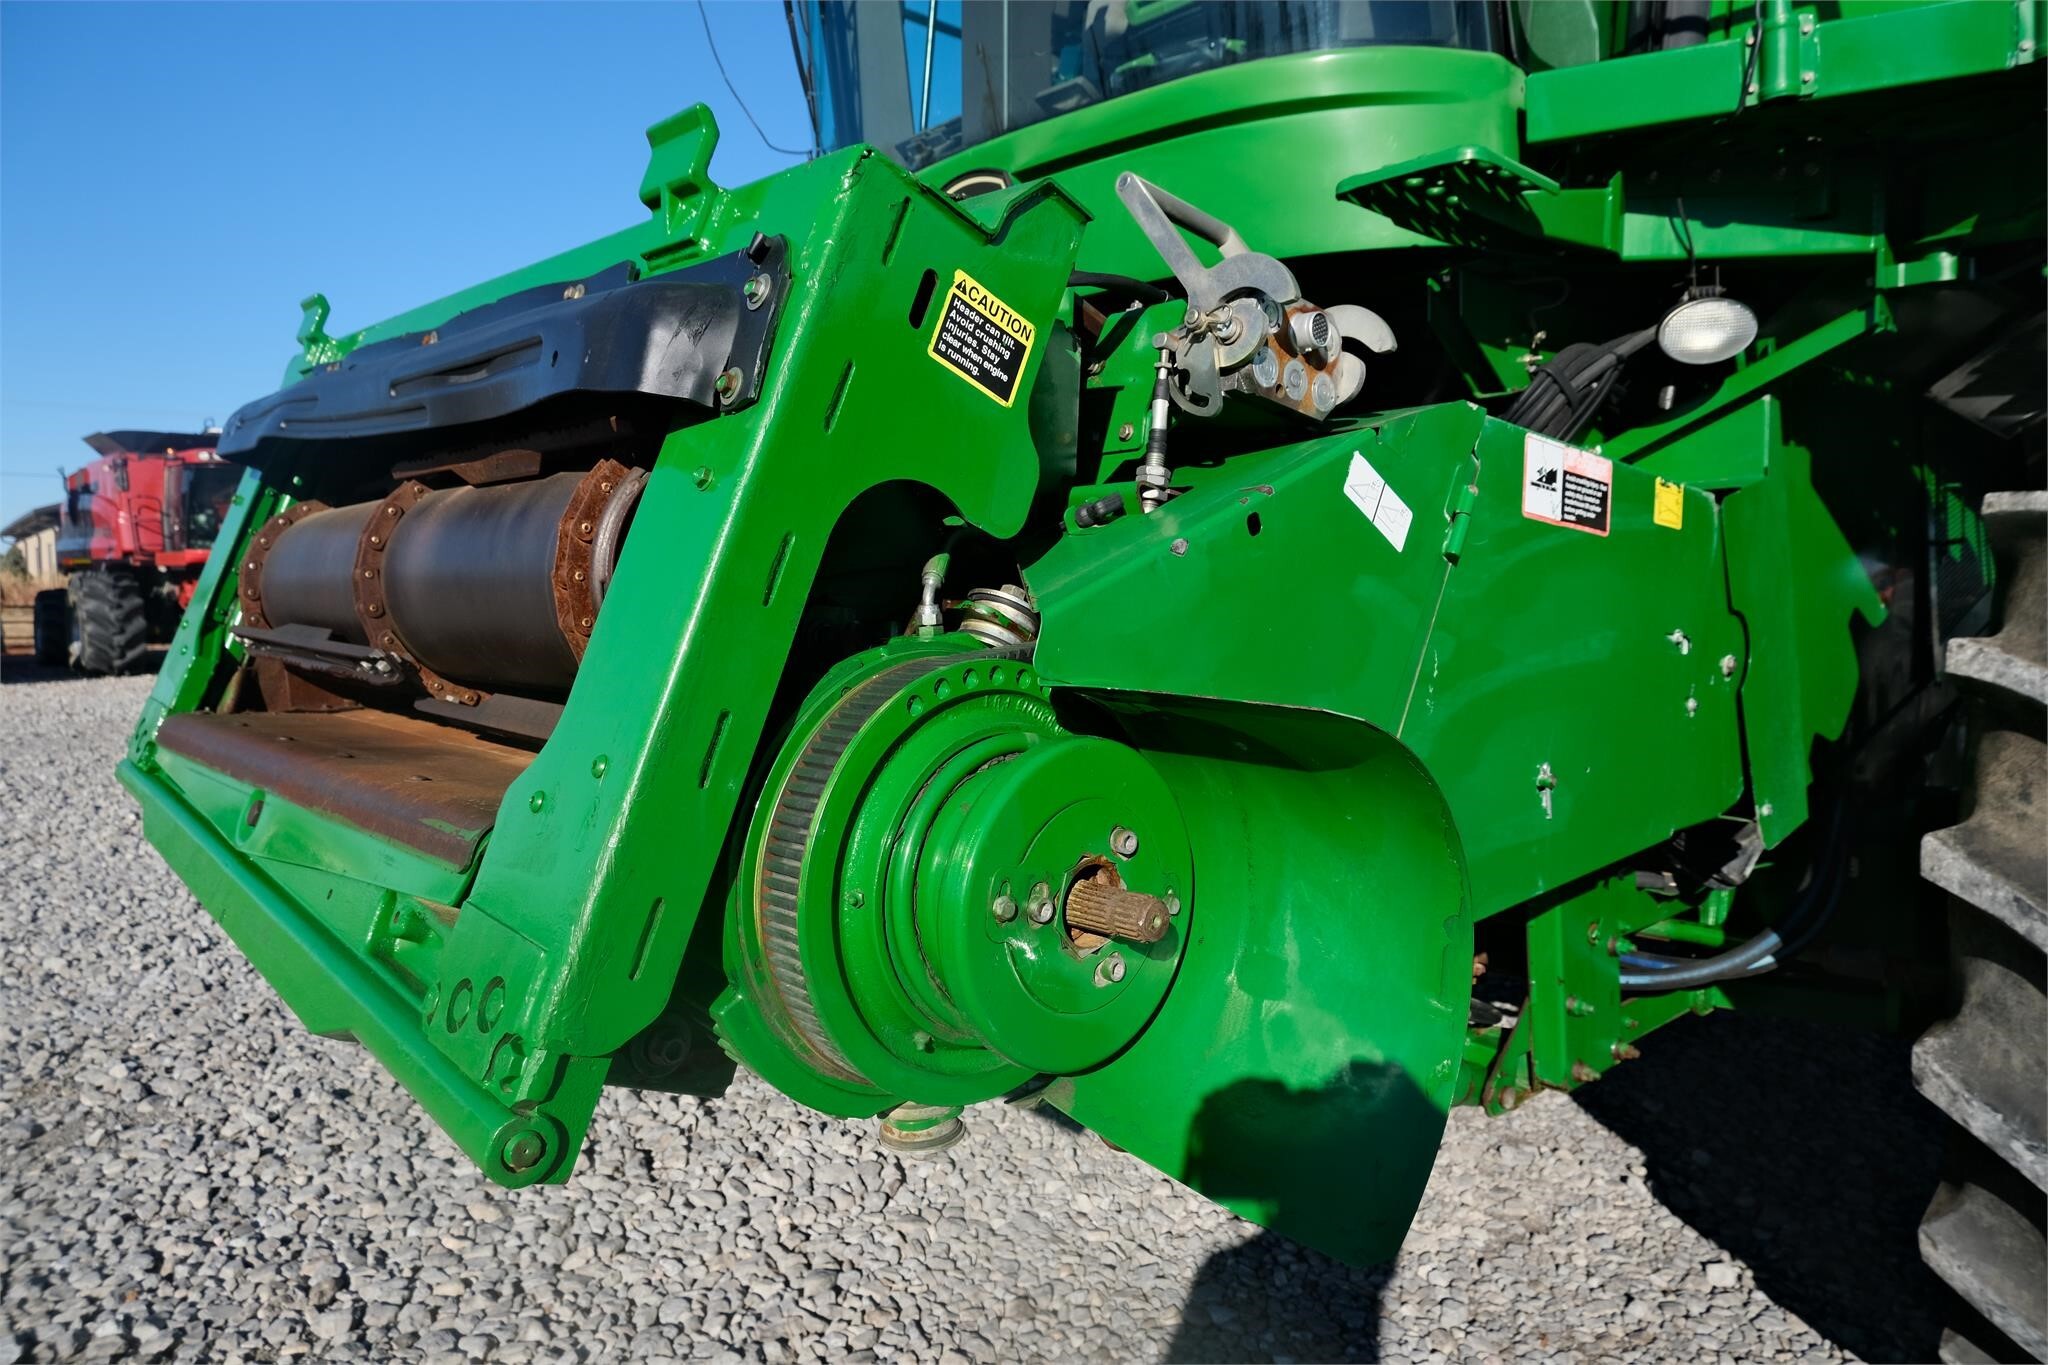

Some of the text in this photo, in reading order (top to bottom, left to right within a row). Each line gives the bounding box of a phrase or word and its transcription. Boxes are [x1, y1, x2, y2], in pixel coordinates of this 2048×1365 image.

[949, 309, 1011, 360] Avoid crushing
[953, 297, 1015, 350] Header can tilt.
[968, 286, 1032, 342] CAUTION
[938, 340, 980, 376] is running.
[942, 331, 1008, 382] clear when engine
[945, 319, 1000, 365] injuries. Stay
